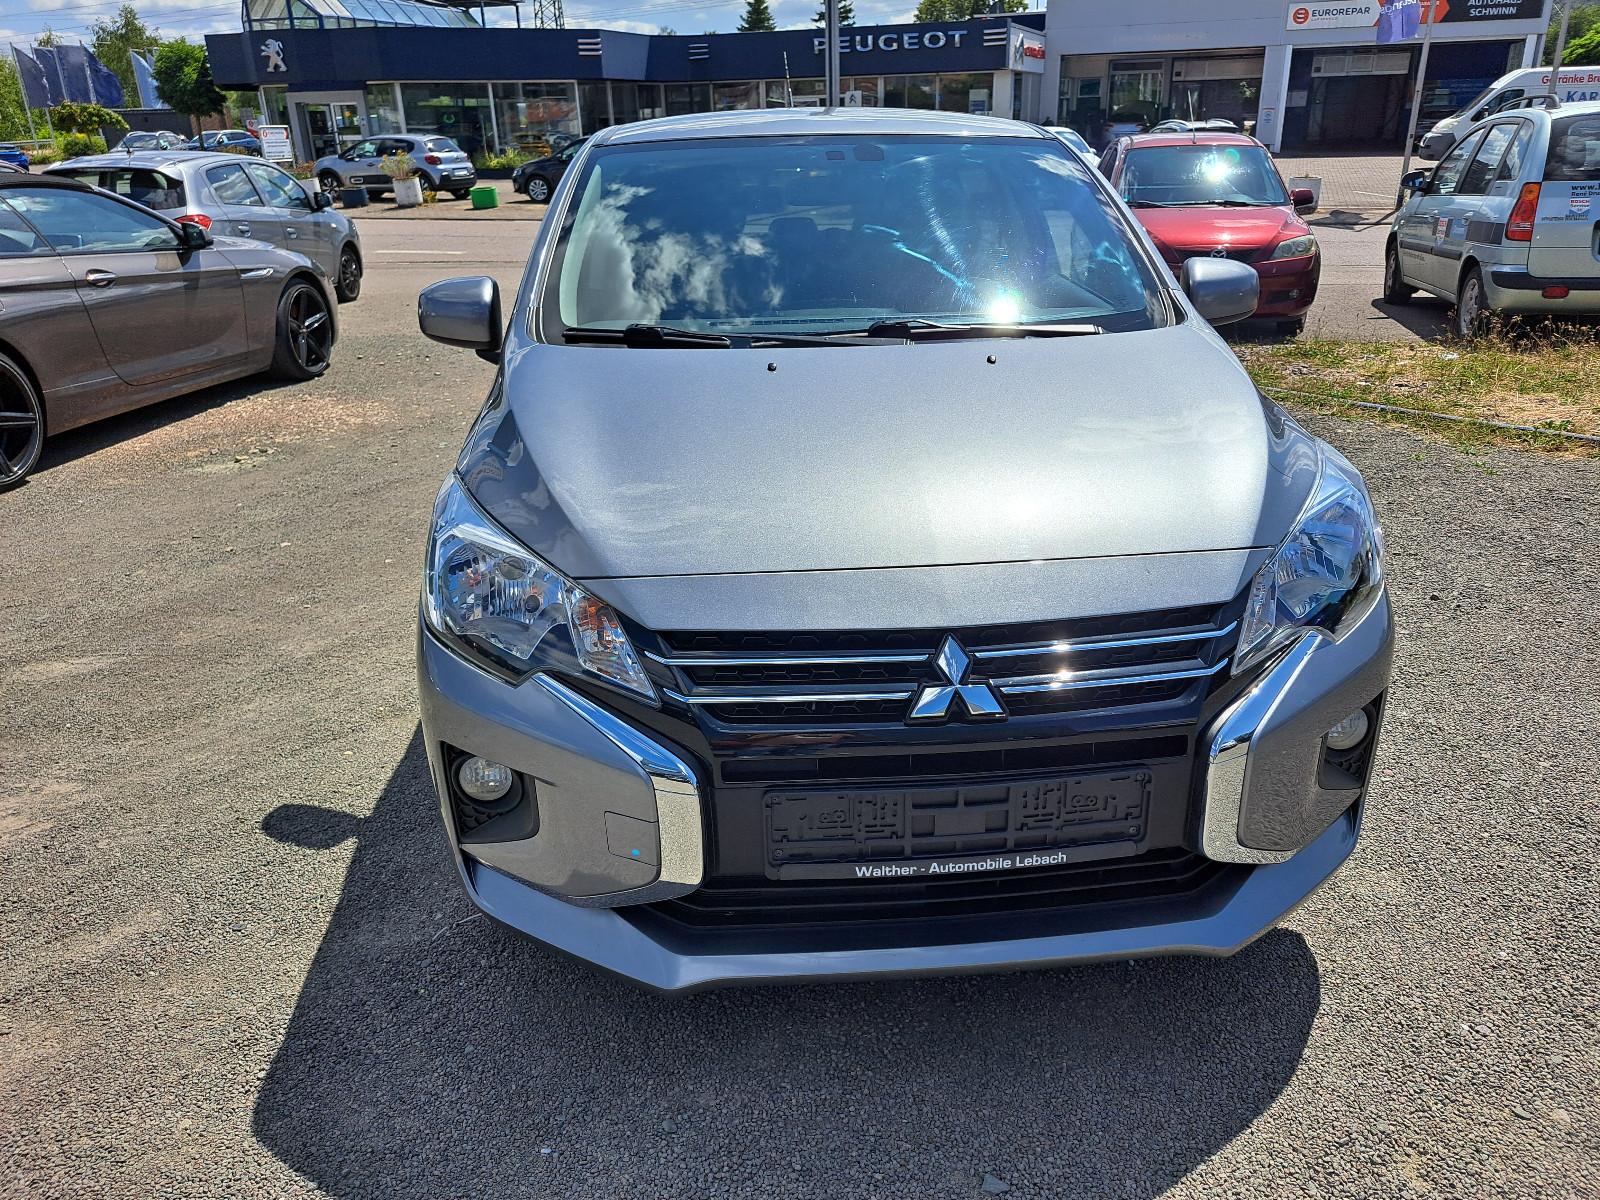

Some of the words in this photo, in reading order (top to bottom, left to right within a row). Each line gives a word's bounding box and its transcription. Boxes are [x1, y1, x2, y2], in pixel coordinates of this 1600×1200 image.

[1311, 7, 1371, 17] EUROREPAR
[1469, 6, 1517, 17] SCHWINN
[813, 30, 968, 55] PEUGEOT
[1541, 73, 1585, 85] Geränke
[855, 865, 918, 878] Walther
[928, 857, 1012, 874] Automobile
[1015, 852, 1067, 867] Lebach
